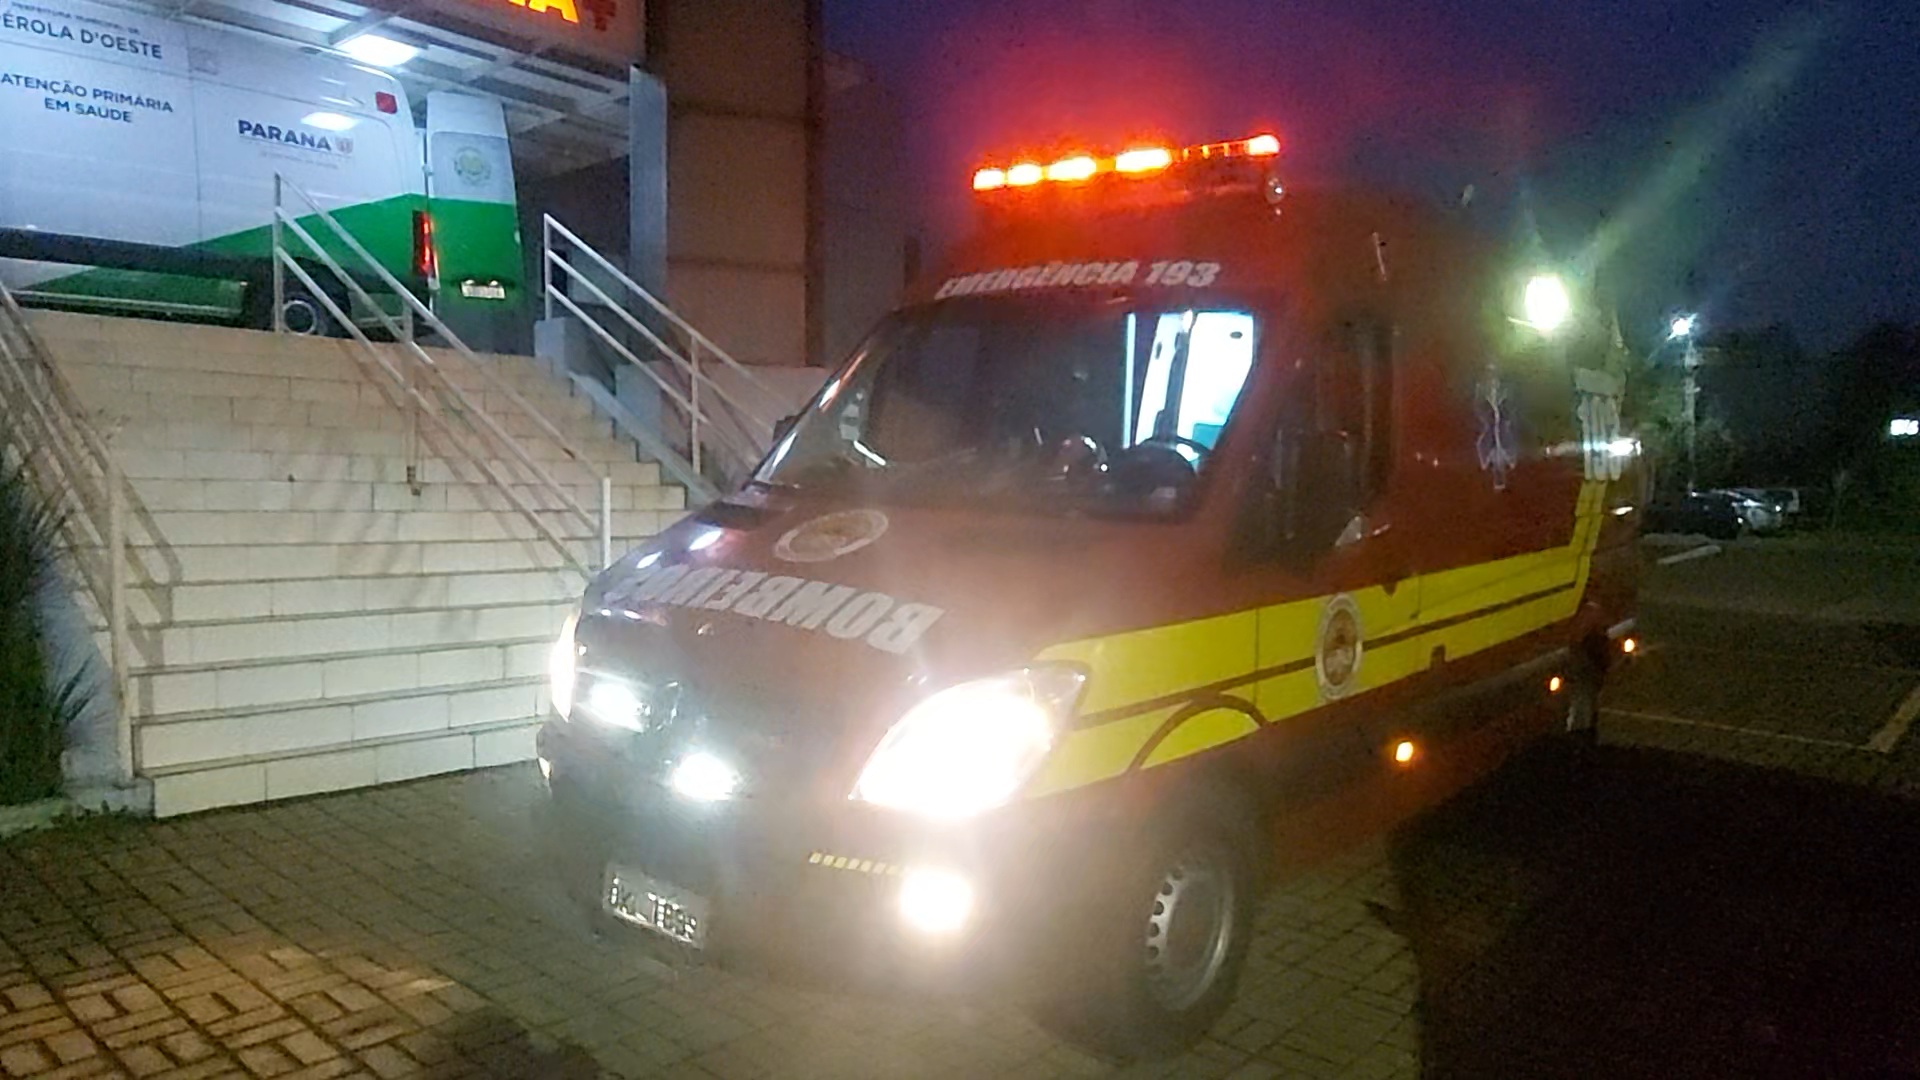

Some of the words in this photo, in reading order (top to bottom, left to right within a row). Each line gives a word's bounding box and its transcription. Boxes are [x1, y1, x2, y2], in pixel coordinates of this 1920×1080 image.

[0, 10, 75, 41] ÉROLA
[80, 28, 163, 59] D'OESTE
[0, 72, 88, 97] ATENÇÃO
[44, 97, 70, 112] EM
[1145, 259, 1220, 287] 193
